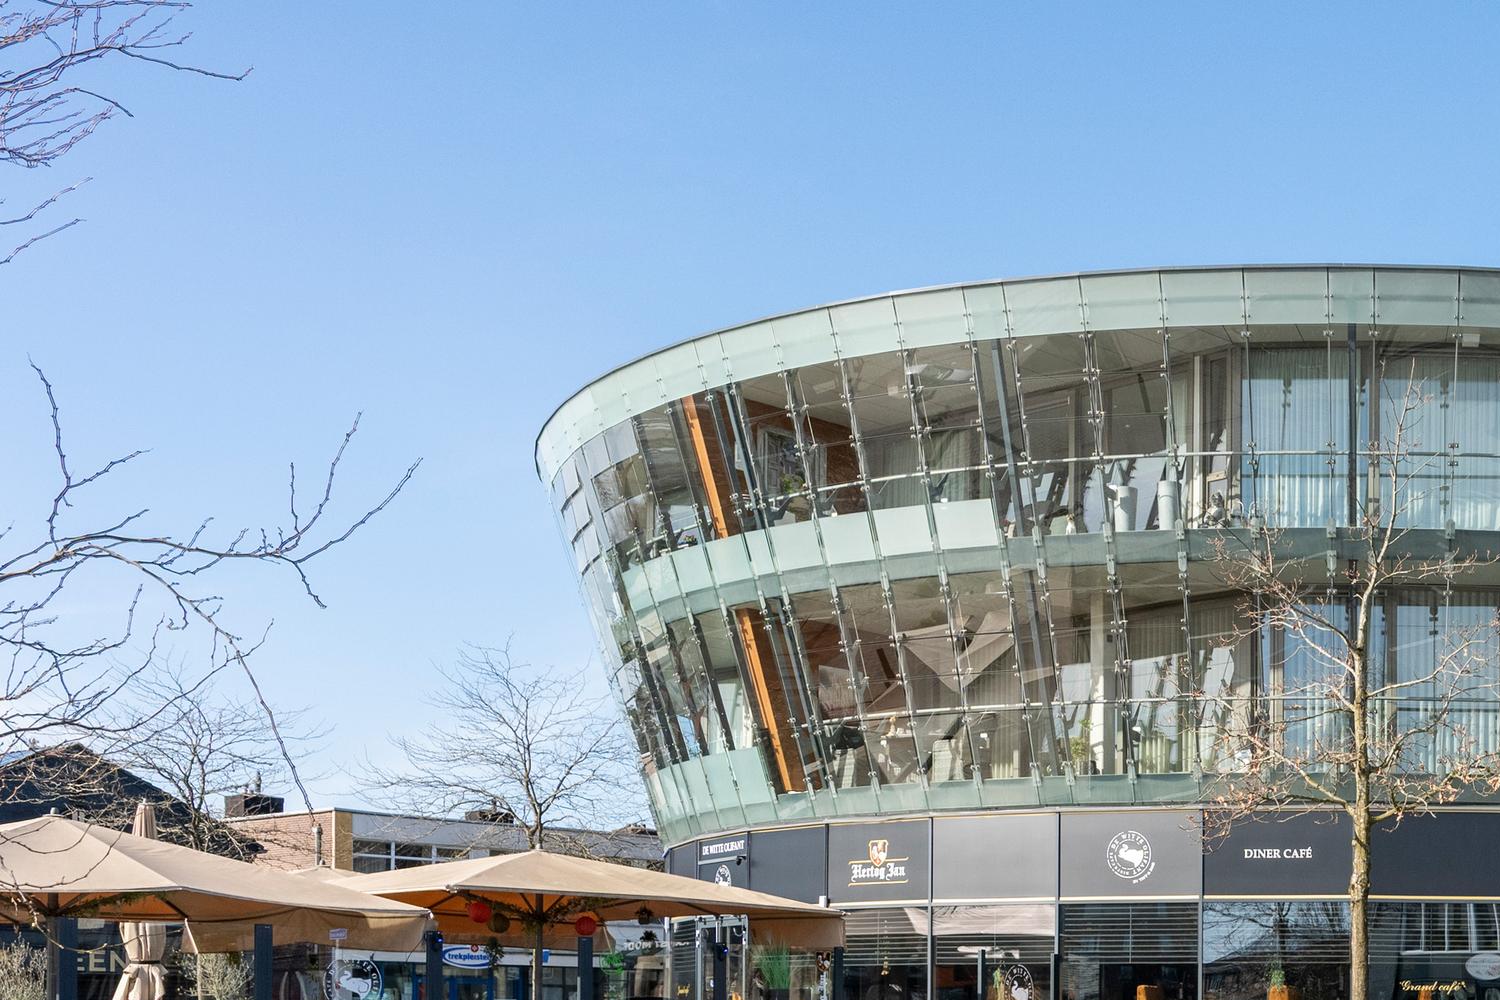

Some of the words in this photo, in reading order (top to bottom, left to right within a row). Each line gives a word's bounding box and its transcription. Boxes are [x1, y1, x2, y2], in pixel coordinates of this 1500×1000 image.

[702, 845, 710, 855] DE
[723, 840, 745, 853] OLIFANT
[1244, 848, 1281, 859] DINER
[1283, 846, 1313, 859] CAFÉ
[851, 864, 886, 882] Hertog
[886, 862, 906, 881] Jan
[448, 952, 491, 962] trekpleiste
